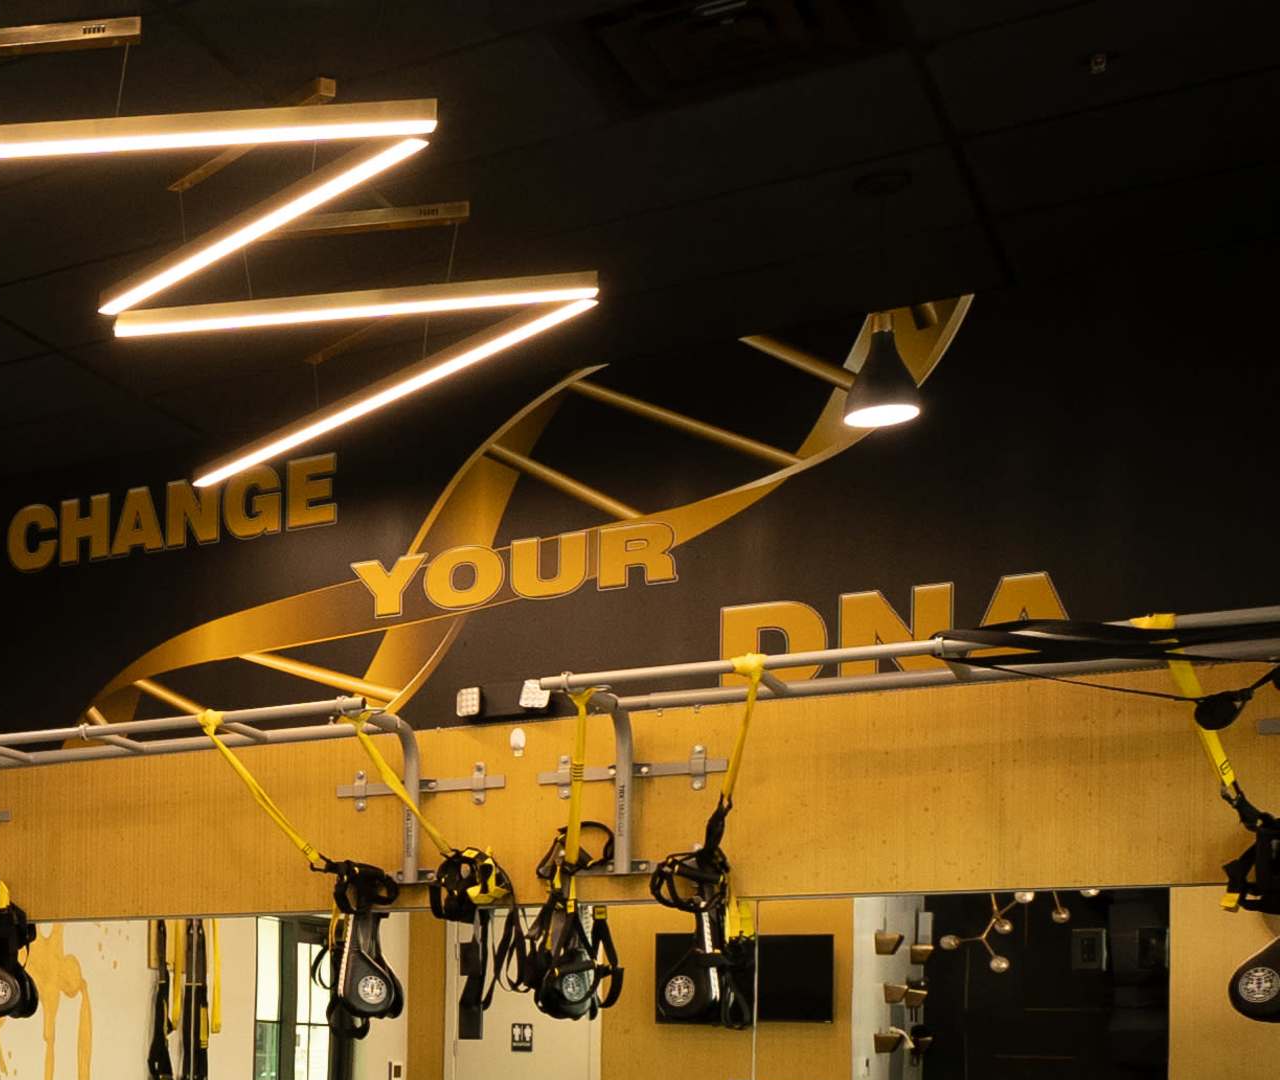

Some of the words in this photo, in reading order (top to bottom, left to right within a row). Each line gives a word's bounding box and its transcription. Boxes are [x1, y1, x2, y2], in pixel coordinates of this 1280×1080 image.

[6, 452, 338, 574] CHANGE
[350, 520, 680, 619] YOUR
[719, 571, 1071, 690] DNA
